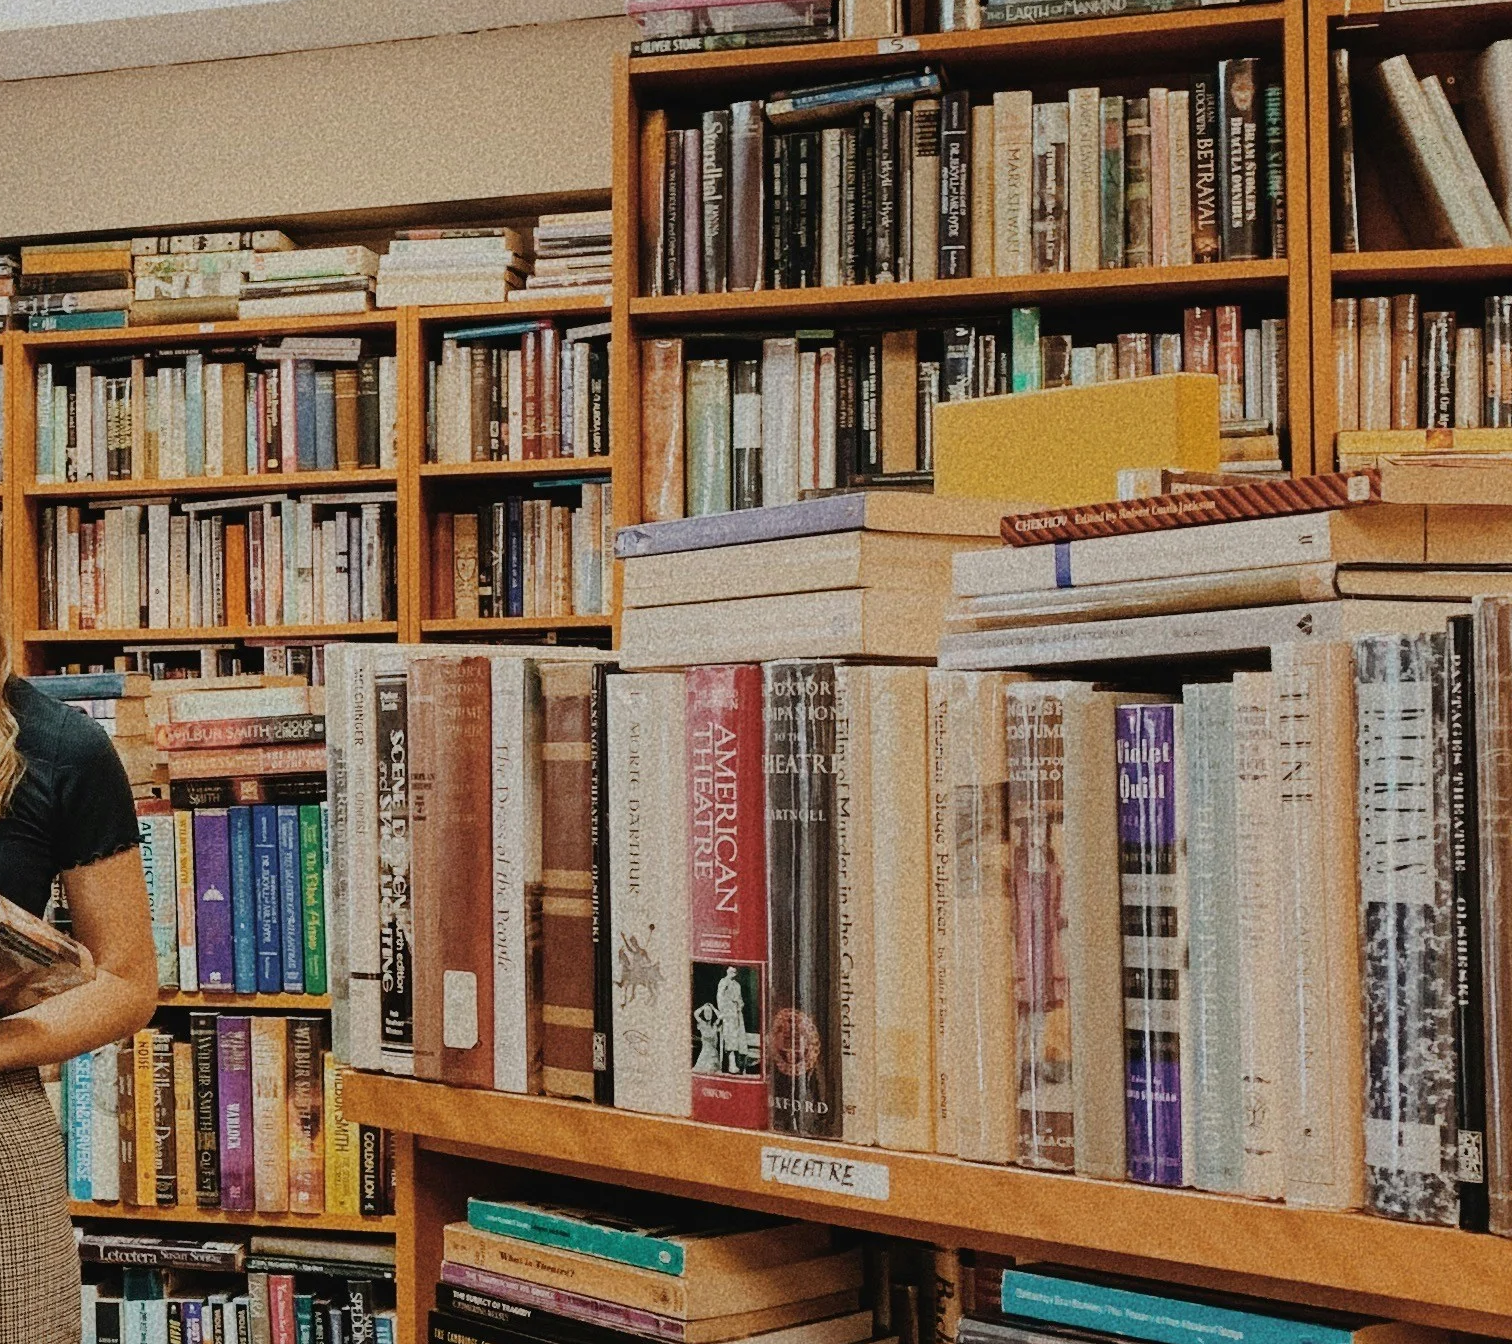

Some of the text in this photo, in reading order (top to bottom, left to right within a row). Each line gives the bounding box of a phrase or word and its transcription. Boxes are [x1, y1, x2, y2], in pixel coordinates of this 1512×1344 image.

[640, 37, 701, 53] OLIVER STONE
[890, 39, 904, 51] S
[1196, 82, 1207, 135] STOCKWIN
[702, 120, 724, 203] Stendhal
[1196, 138, 1215, 230] BETRAYAL
[1231, 117, 1243, 228] DRACULA OMNIBUS
[1244, 123, 1256, 221] BRAM STOKER'S
[1006, 148, 1021, 254] MARY STEWART
[1014, 515, 1068, 533] CHEKHOV
[1073, 510, 1103, 525] Edited
[1104, 508, 1117, 523] by
[1118, 505, 1149, 522] Robert
[1178, 497, 1216, 515] Jackson
[1450, 654, 1464, 765] PANTAGES
[629, 722, 641, 791] MORTE
[836, 718, 850, 764] Film
[693, 720, 715, 881] THEATRE
[1120, 772, 1165, 803] Quill
[712, 722, 739, 914] AMERICAN
[837, 797, 852, 879] Murder
[1452, 772, 1466, 872] THEATRE
[838, 886, 852, 905] in
[839, 912, 853, 946] the
[840, 955, 855, 1057] Cathedral
[199, 1034, 209, 1136] WILBUR SMITH
[226, 1103, 241, 1150] WARLOCK
[202, 1151, 211, 1192] QUEST
[364, 1131, 375, 1199] GOLDEN LION
[765, 1153, 857, 1189] THEATRE
[213, 1309, 222, 1335] WOLE
[237, 1309, 247, 1335] WOLE
[363, 1313, 373, 1338] SALLY
[453, 1290, 531, 1318] THE SUBJECT OF TRAGEDY
